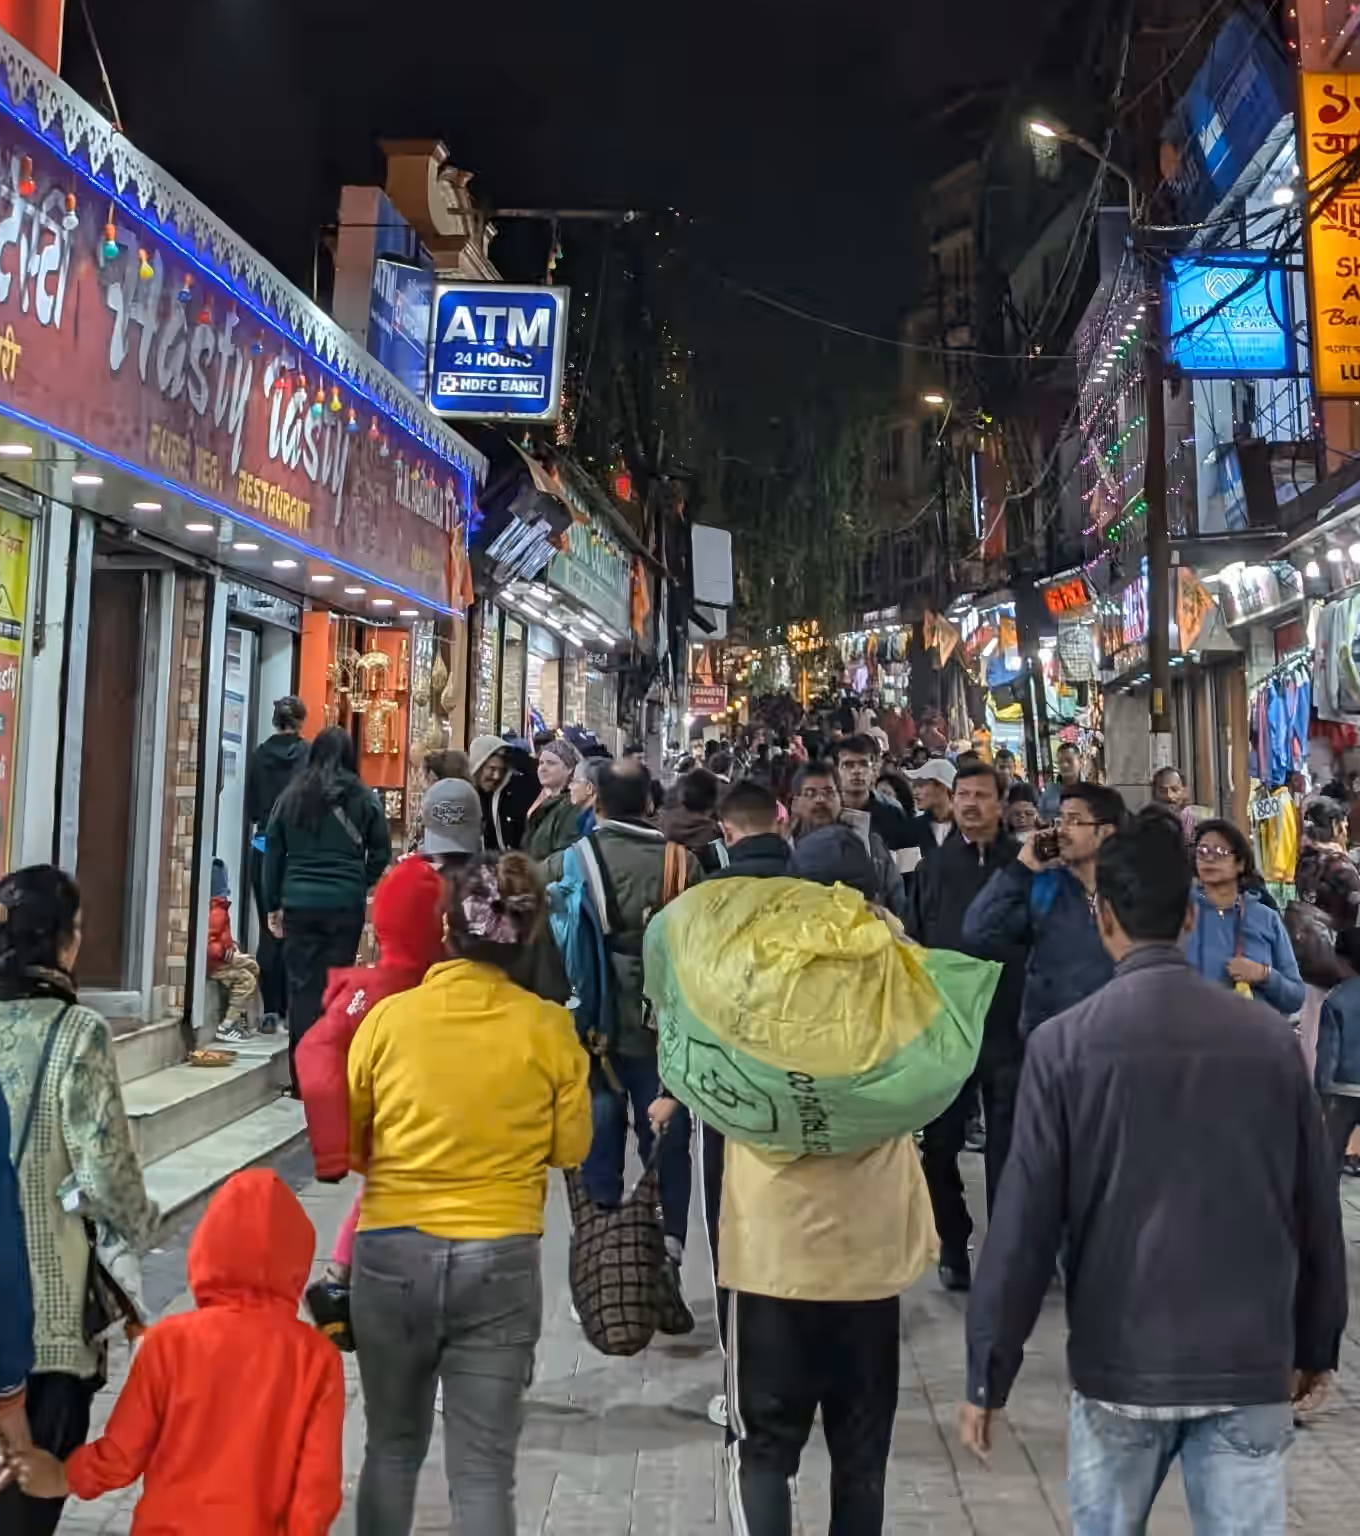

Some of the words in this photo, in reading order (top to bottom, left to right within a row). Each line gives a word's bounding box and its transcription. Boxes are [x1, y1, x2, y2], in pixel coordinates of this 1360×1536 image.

[443, 306, 551, 347] ATM
[454, 352, 472, 365] 24
[460, 378, 497, 391] HDFC
[501, 380, 539, 392] BANK
[238, 469, 311, 534] RESTAURANT
[1255, 800, 1280, 816] 800
